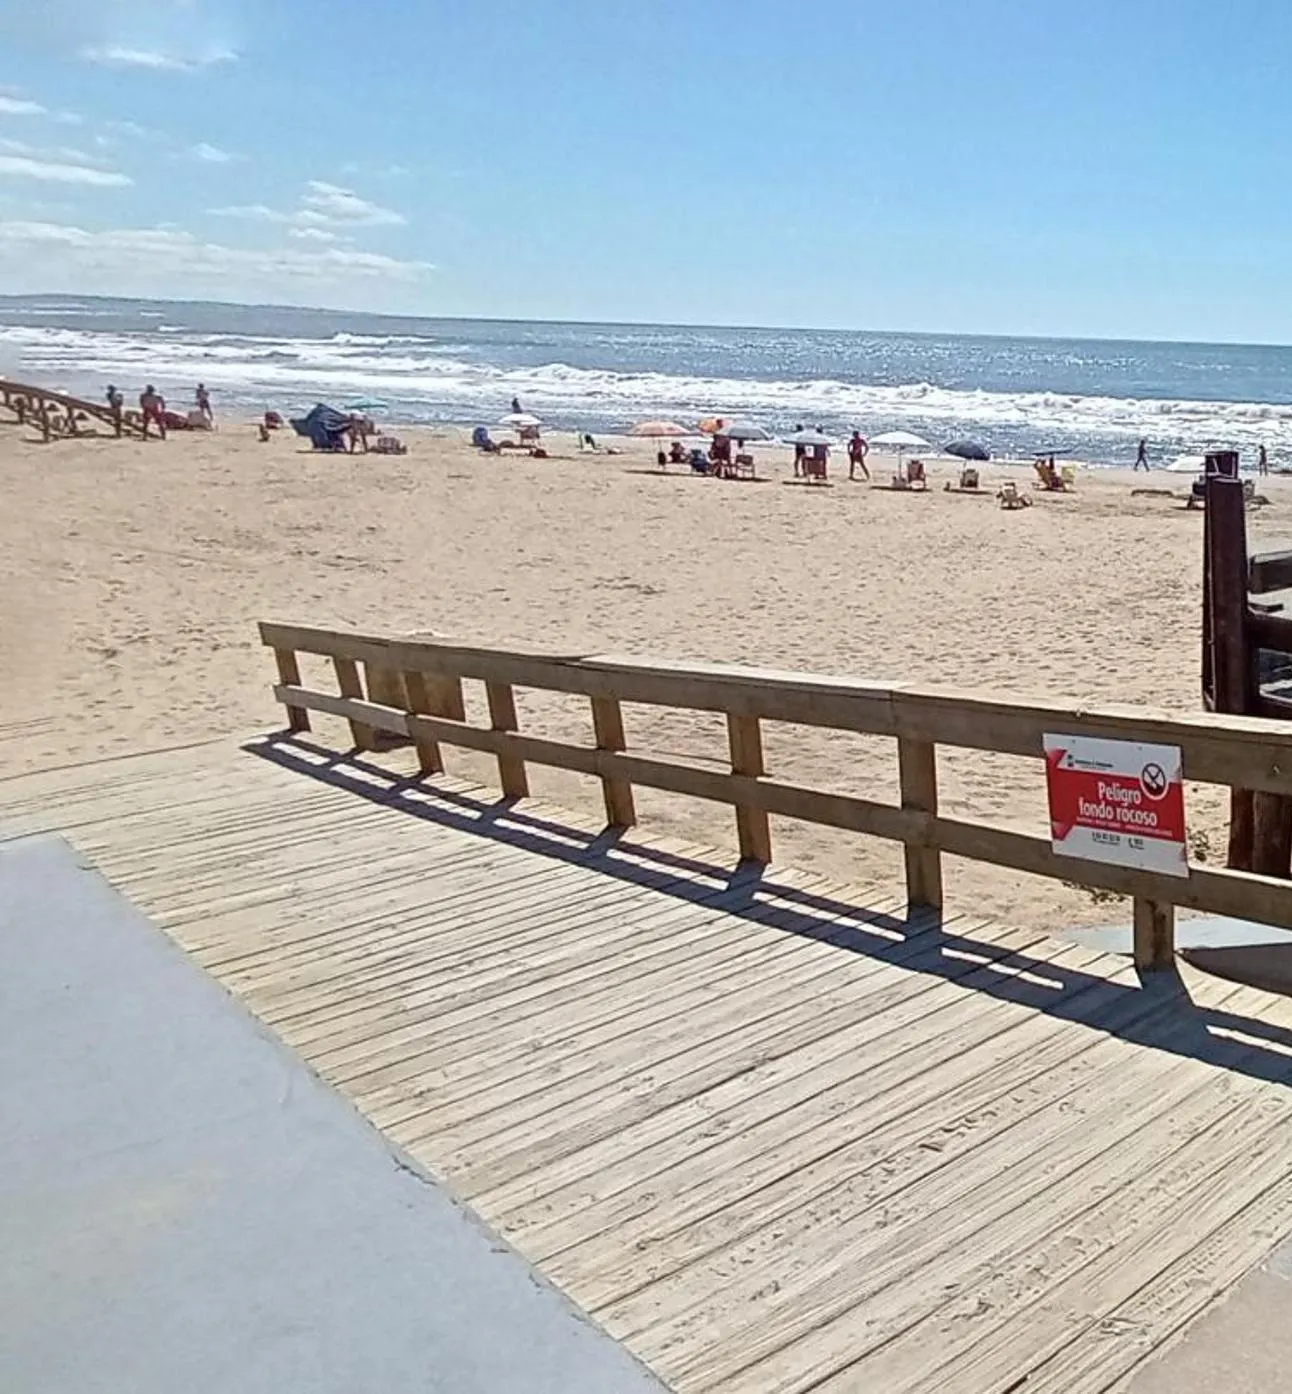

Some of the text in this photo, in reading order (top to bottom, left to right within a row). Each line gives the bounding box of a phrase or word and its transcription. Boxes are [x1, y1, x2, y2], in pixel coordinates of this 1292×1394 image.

[1098, 781, 1142, 806] Peligro
[1078, 796, 1114, 820] fondo
[1116, 807, 1158, 827] rocoso
